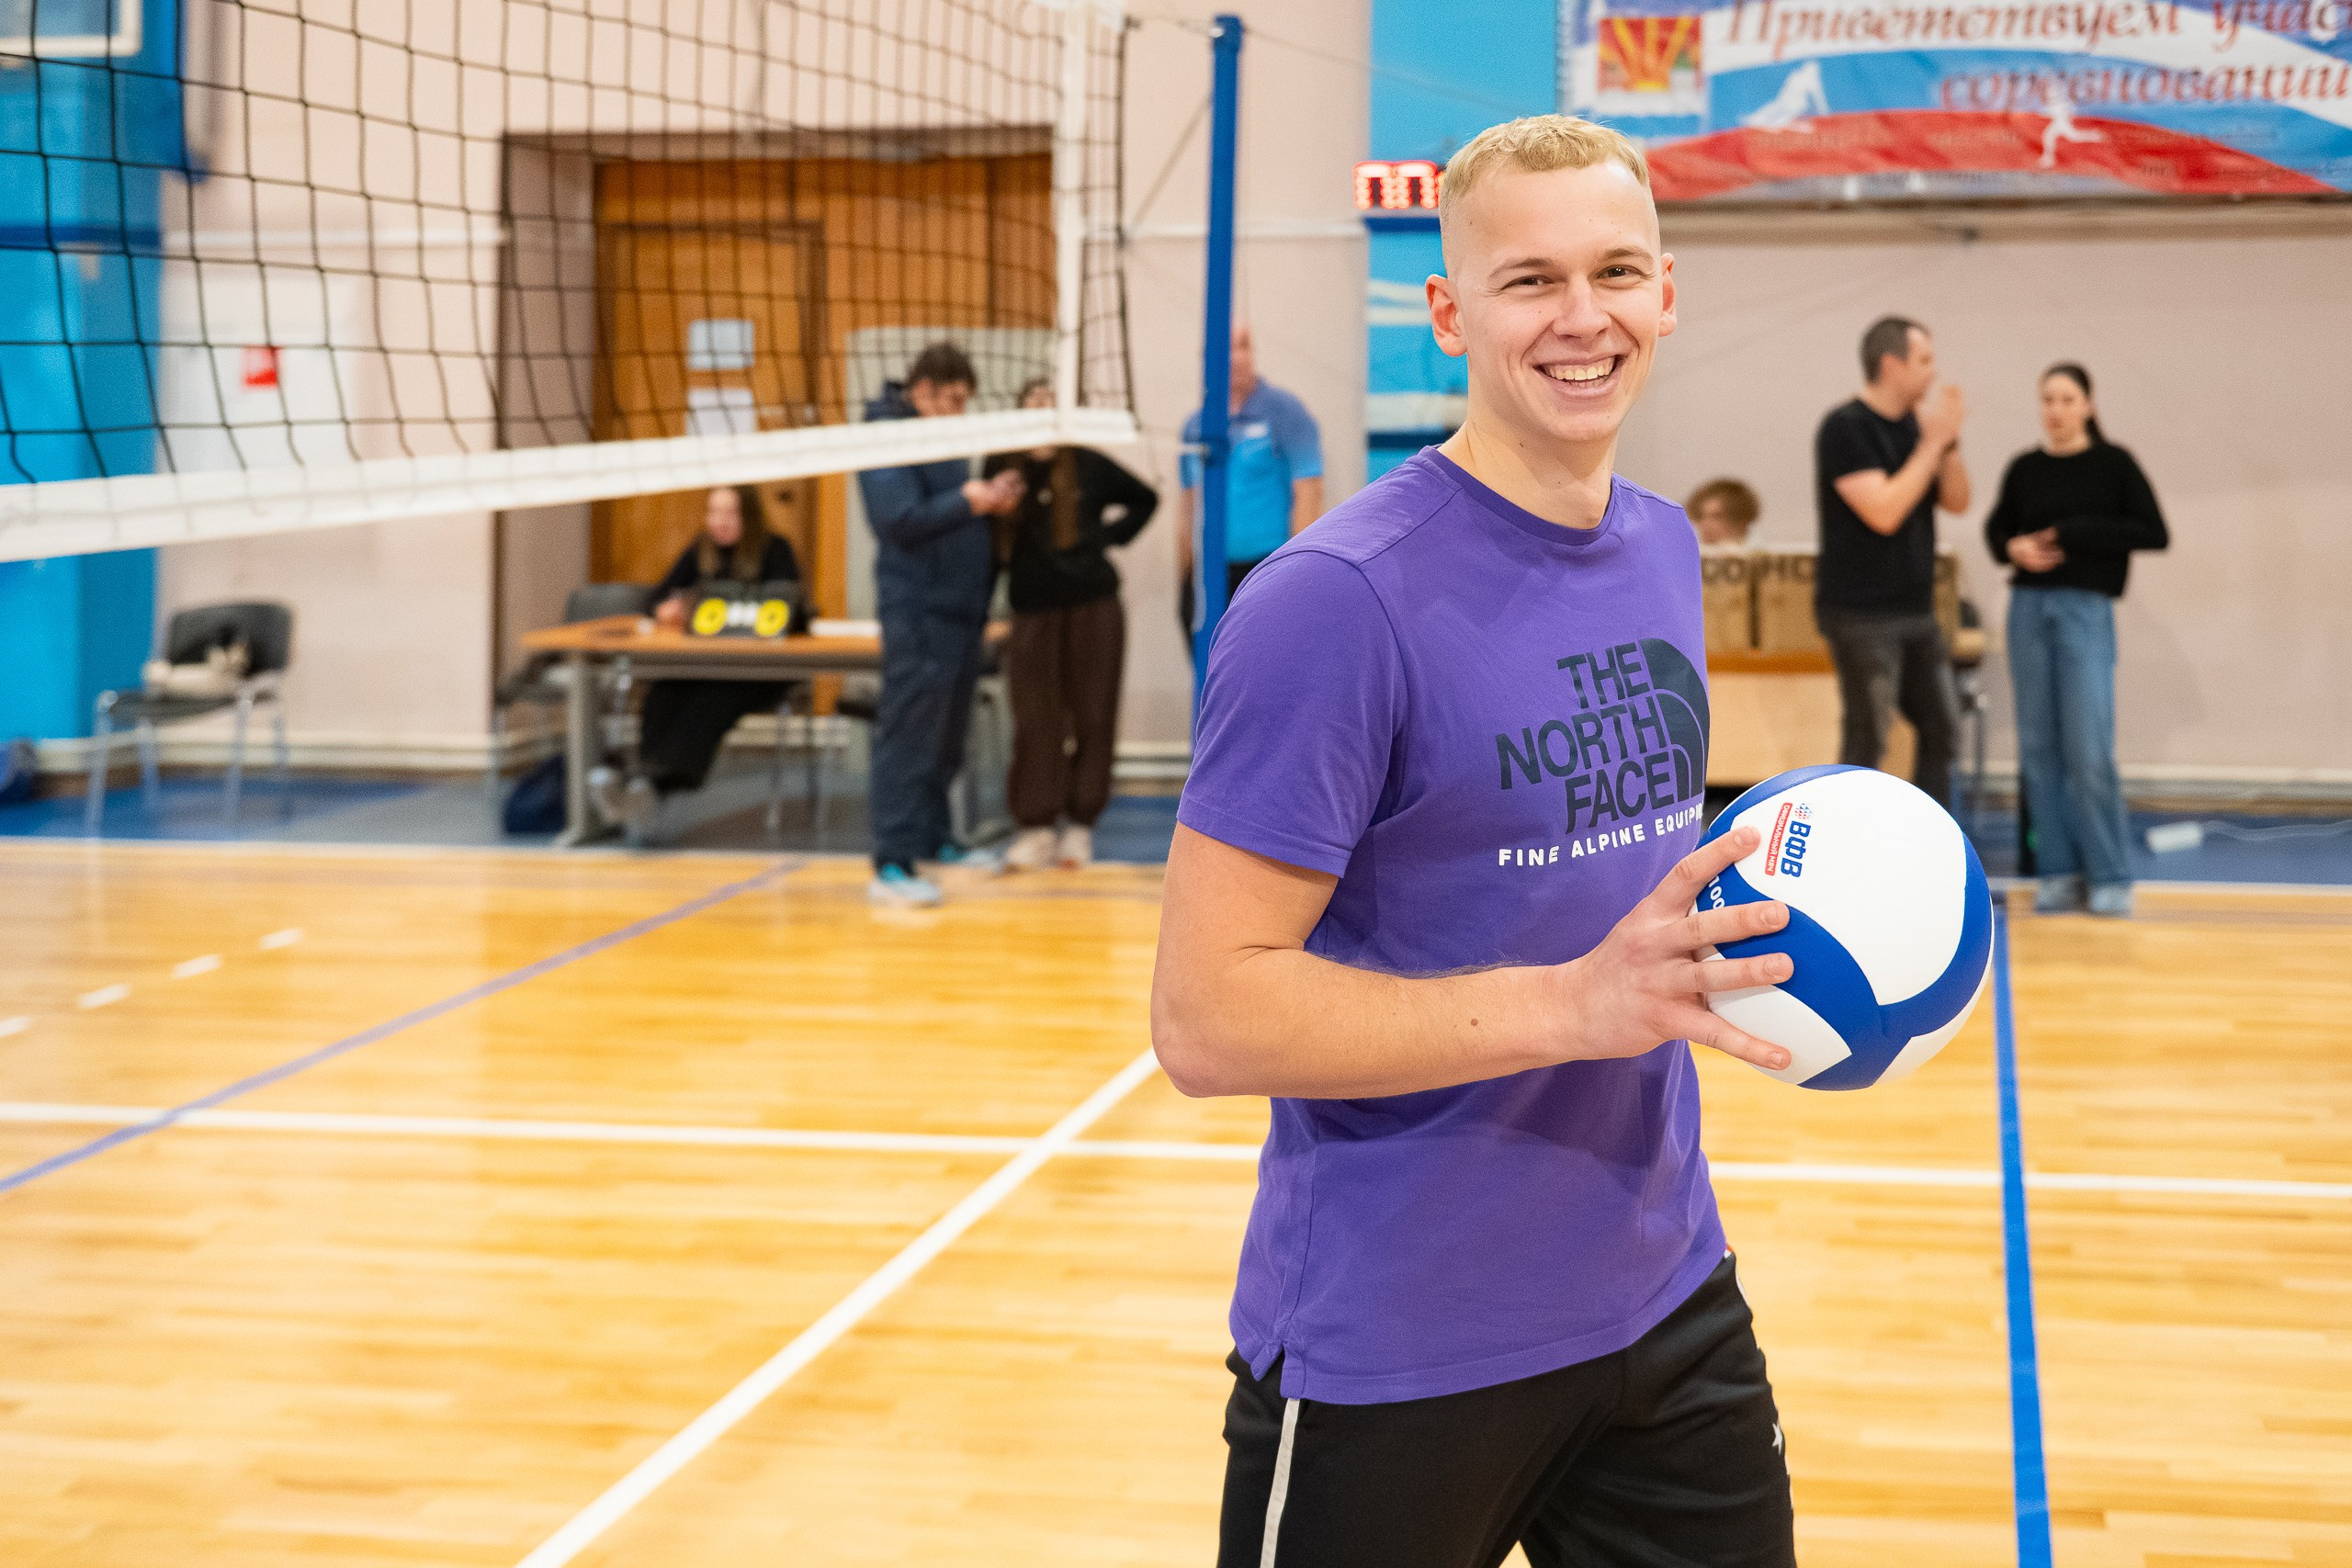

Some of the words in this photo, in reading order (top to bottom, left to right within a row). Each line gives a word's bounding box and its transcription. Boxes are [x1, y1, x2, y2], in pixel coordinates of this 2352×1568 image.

[2212, 0, 2352, 53] учас
[1556, 641, 1651, 709] THE
[1495, 693, 1668, 791] NORTH
[1565, 750, 1675, 835] FACE
[1498, 845, 1560, 866] FINE
[1571, 823, 1646, 859] ALPINE
[1781, 820, 1812, 878] ВФВ
